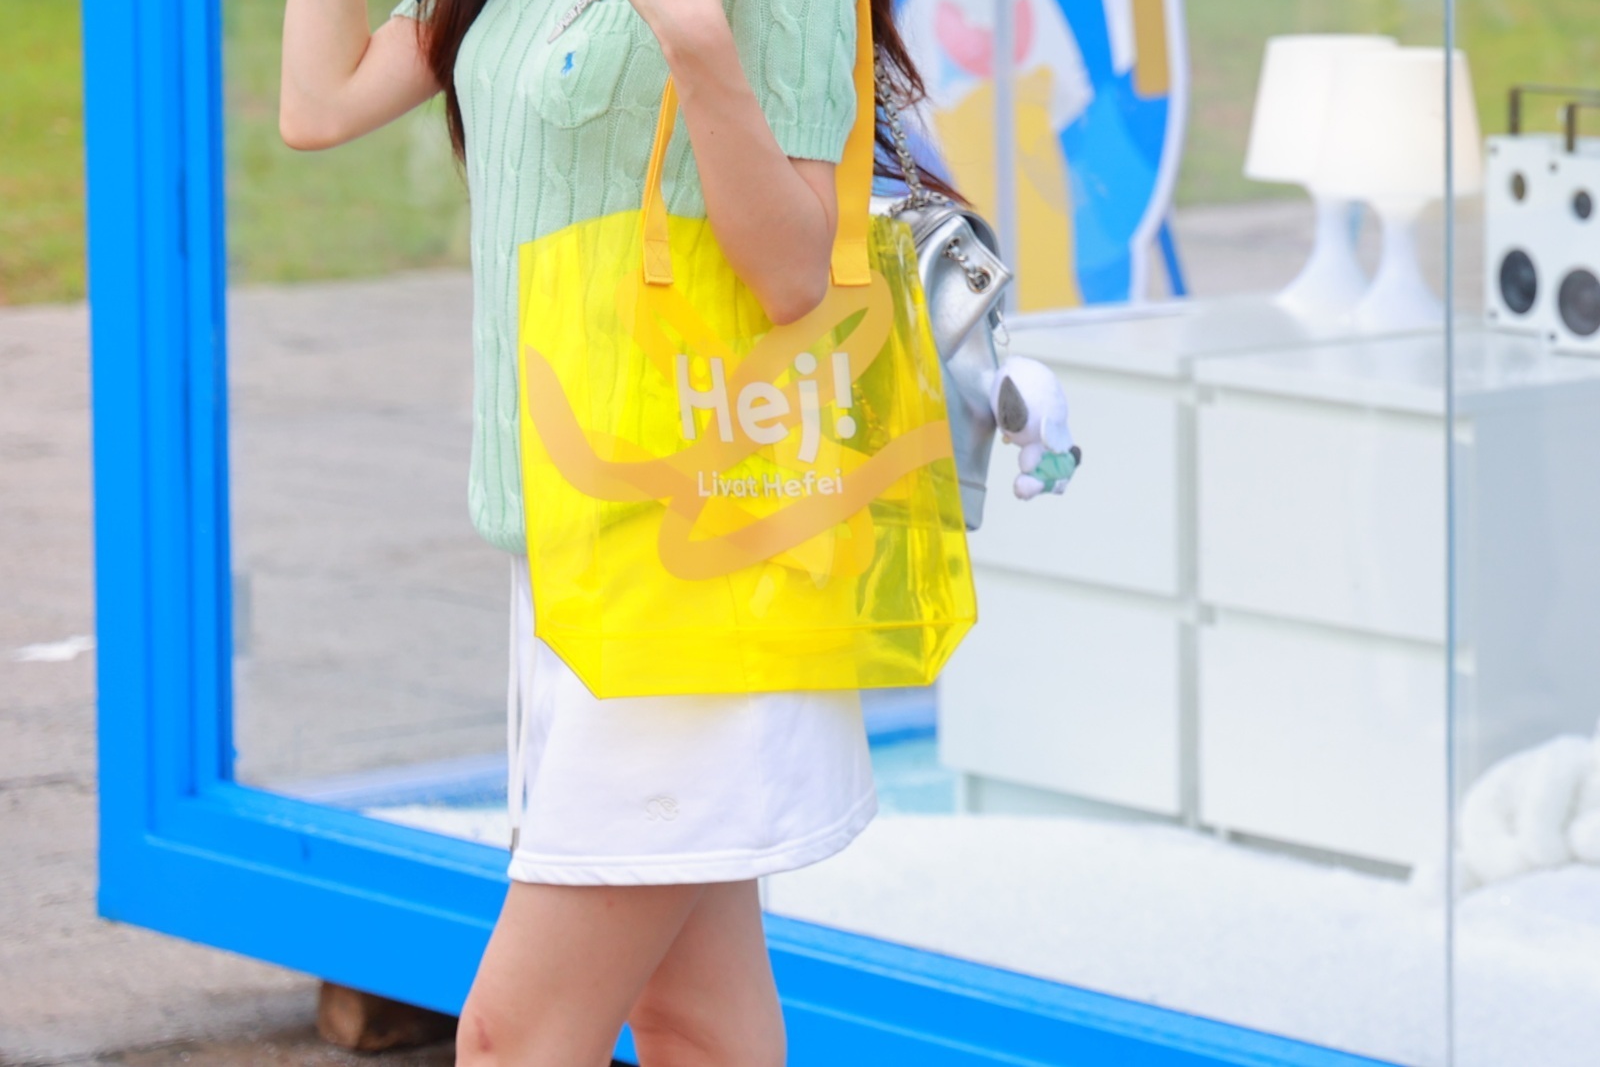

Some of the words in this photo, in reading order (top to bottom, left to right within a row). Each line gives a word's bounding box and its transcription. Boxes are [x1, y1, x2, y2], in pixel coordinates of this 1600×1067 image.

[673, 352, 857, 463] Hej!
[697, 470, 760, 498] Livat
[763, 468, 844, 497] Hefei
